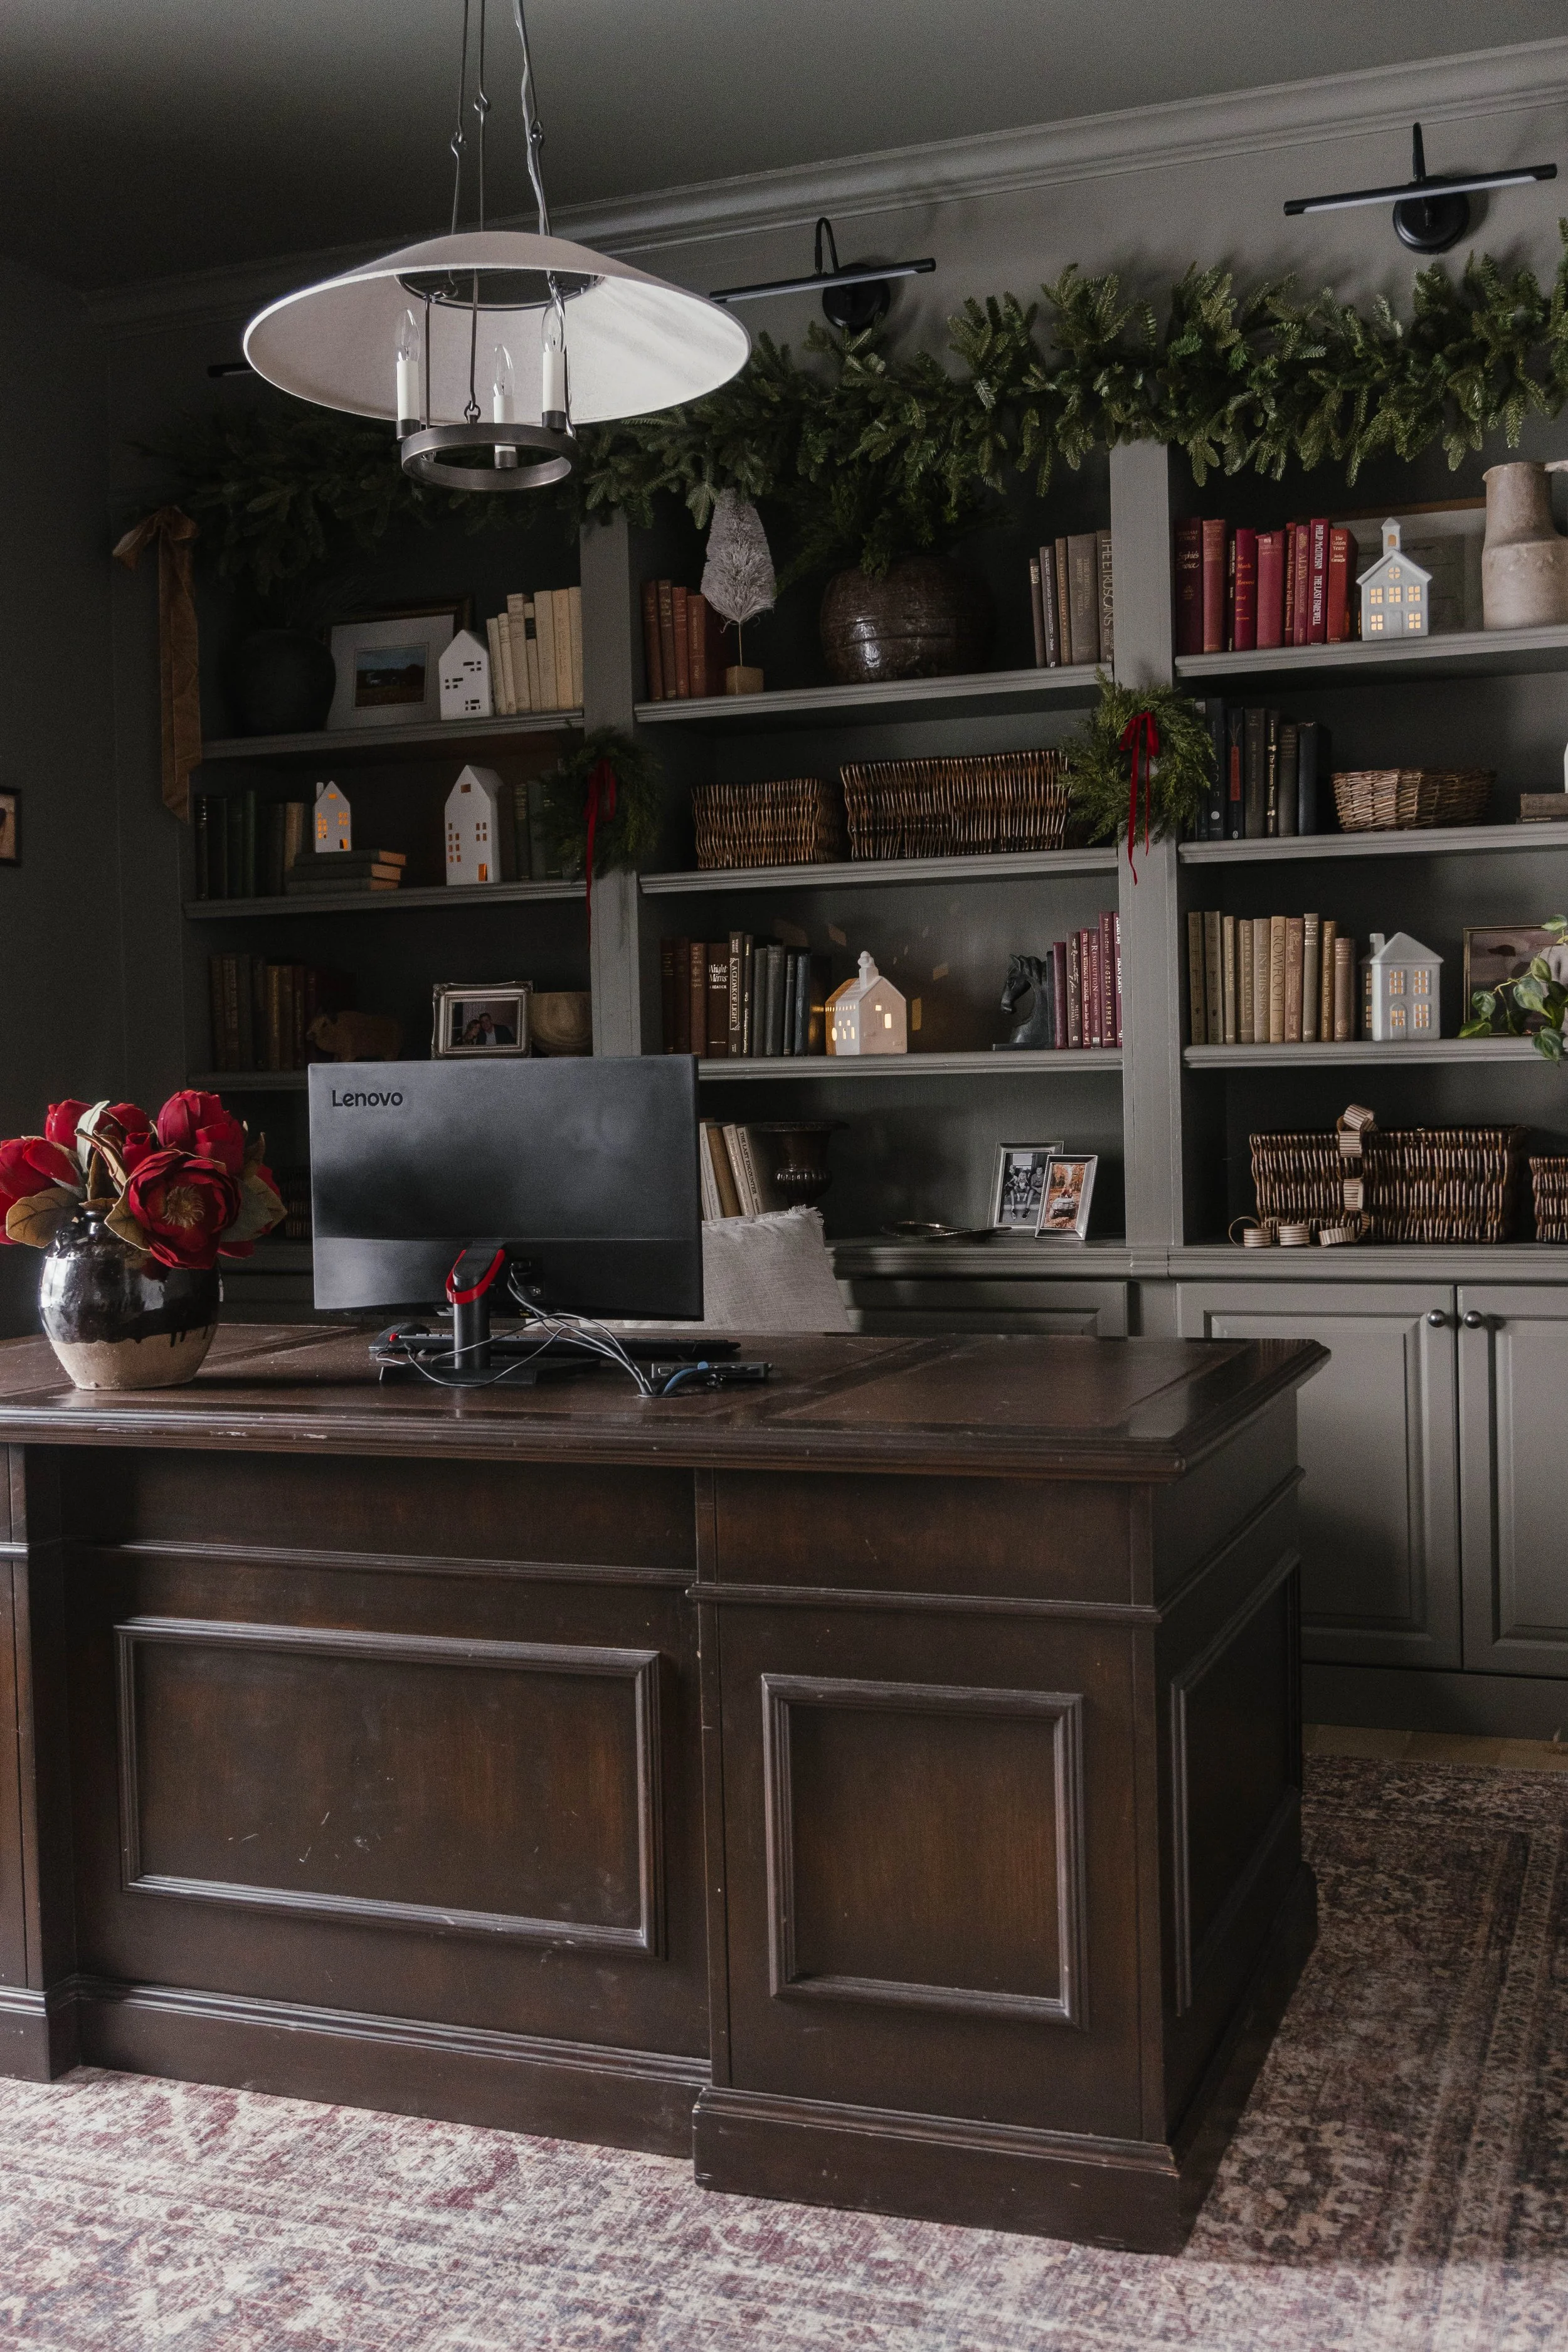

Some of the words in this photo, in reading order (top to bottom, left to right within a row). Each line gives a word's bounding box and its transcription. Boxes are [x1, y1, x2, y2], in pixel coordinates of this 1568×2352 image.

[1315, 524, 1323, 541] PHILIP
[1102, 539, 1112, 560] THE
[1298, 553, 1307, 581] ALIYA
[1314, 575, 1322, 586] THE
[1103, 561, 1114, 626] ETRUSCANS
[1313, 586, 1322, 599] LAST
[1312, 599, 1322, 625] FAREWELL
[1259, 953, 1267, 963] IN
[1273, 925, 1283, 1004] CROWFOOT
[709, 963, 728, 976] Wright
[709, 973, 728, 983] Morris
[732, 993, 737, 1001] OF
[1259, 992, 1267, 1017] SIGN
[332, 1089, 403, 1107] Lenovo
[745, 1160, 757, 1194] ENCOUNTER
